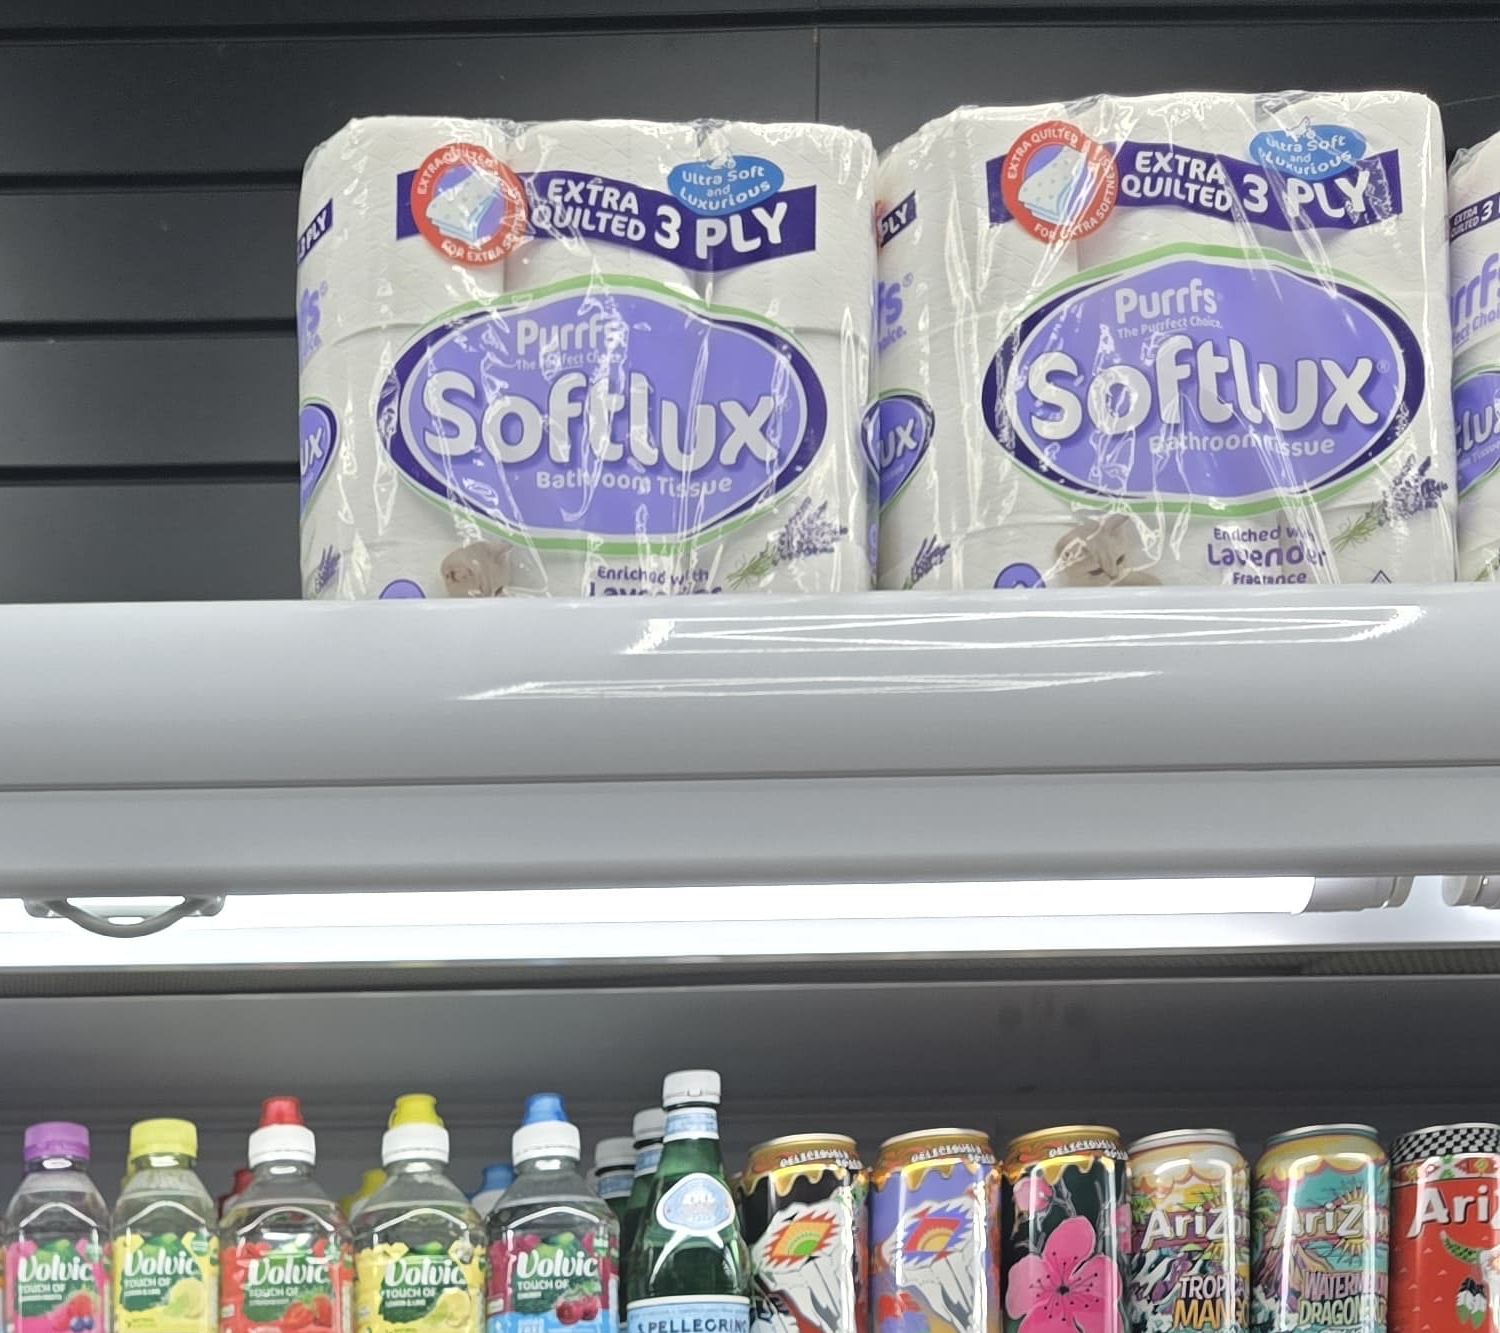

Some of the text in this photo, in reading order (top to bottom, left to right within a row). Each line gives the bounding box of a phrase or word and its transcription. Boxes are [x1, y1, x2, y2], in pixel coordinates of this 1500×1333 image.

[1264, 133, 1348, 154] Ultra Soft
[681, 164, 765, 186] Ultra Soft
[1135, 151, 1228, 184] EXTRA
[546, 178, 640, 215] EXTRA
[707, 184, 731, 198] and
[1121, 175, 1234, 213] QUILTED
[1242, 169, 1371, 219] 3 PLY
[531, 199, 647, 242] QUILTED
[654, 202, 789, 259] 3 PLY
[1115, 276, 1218, 324] Purrfs
[1026, 333, 1380, 441] Softlux
[422, 370, 778, 472] Softlux
[656, 475, 733, 496] Tissue
[1212, 525, 1281, 544] Enriched
[1206, 542, 1328, 570] Lavender
[381, 1288, 437, 1300] TOUCH OF
[516, 1280, 570, 1292] TOUCH OF
